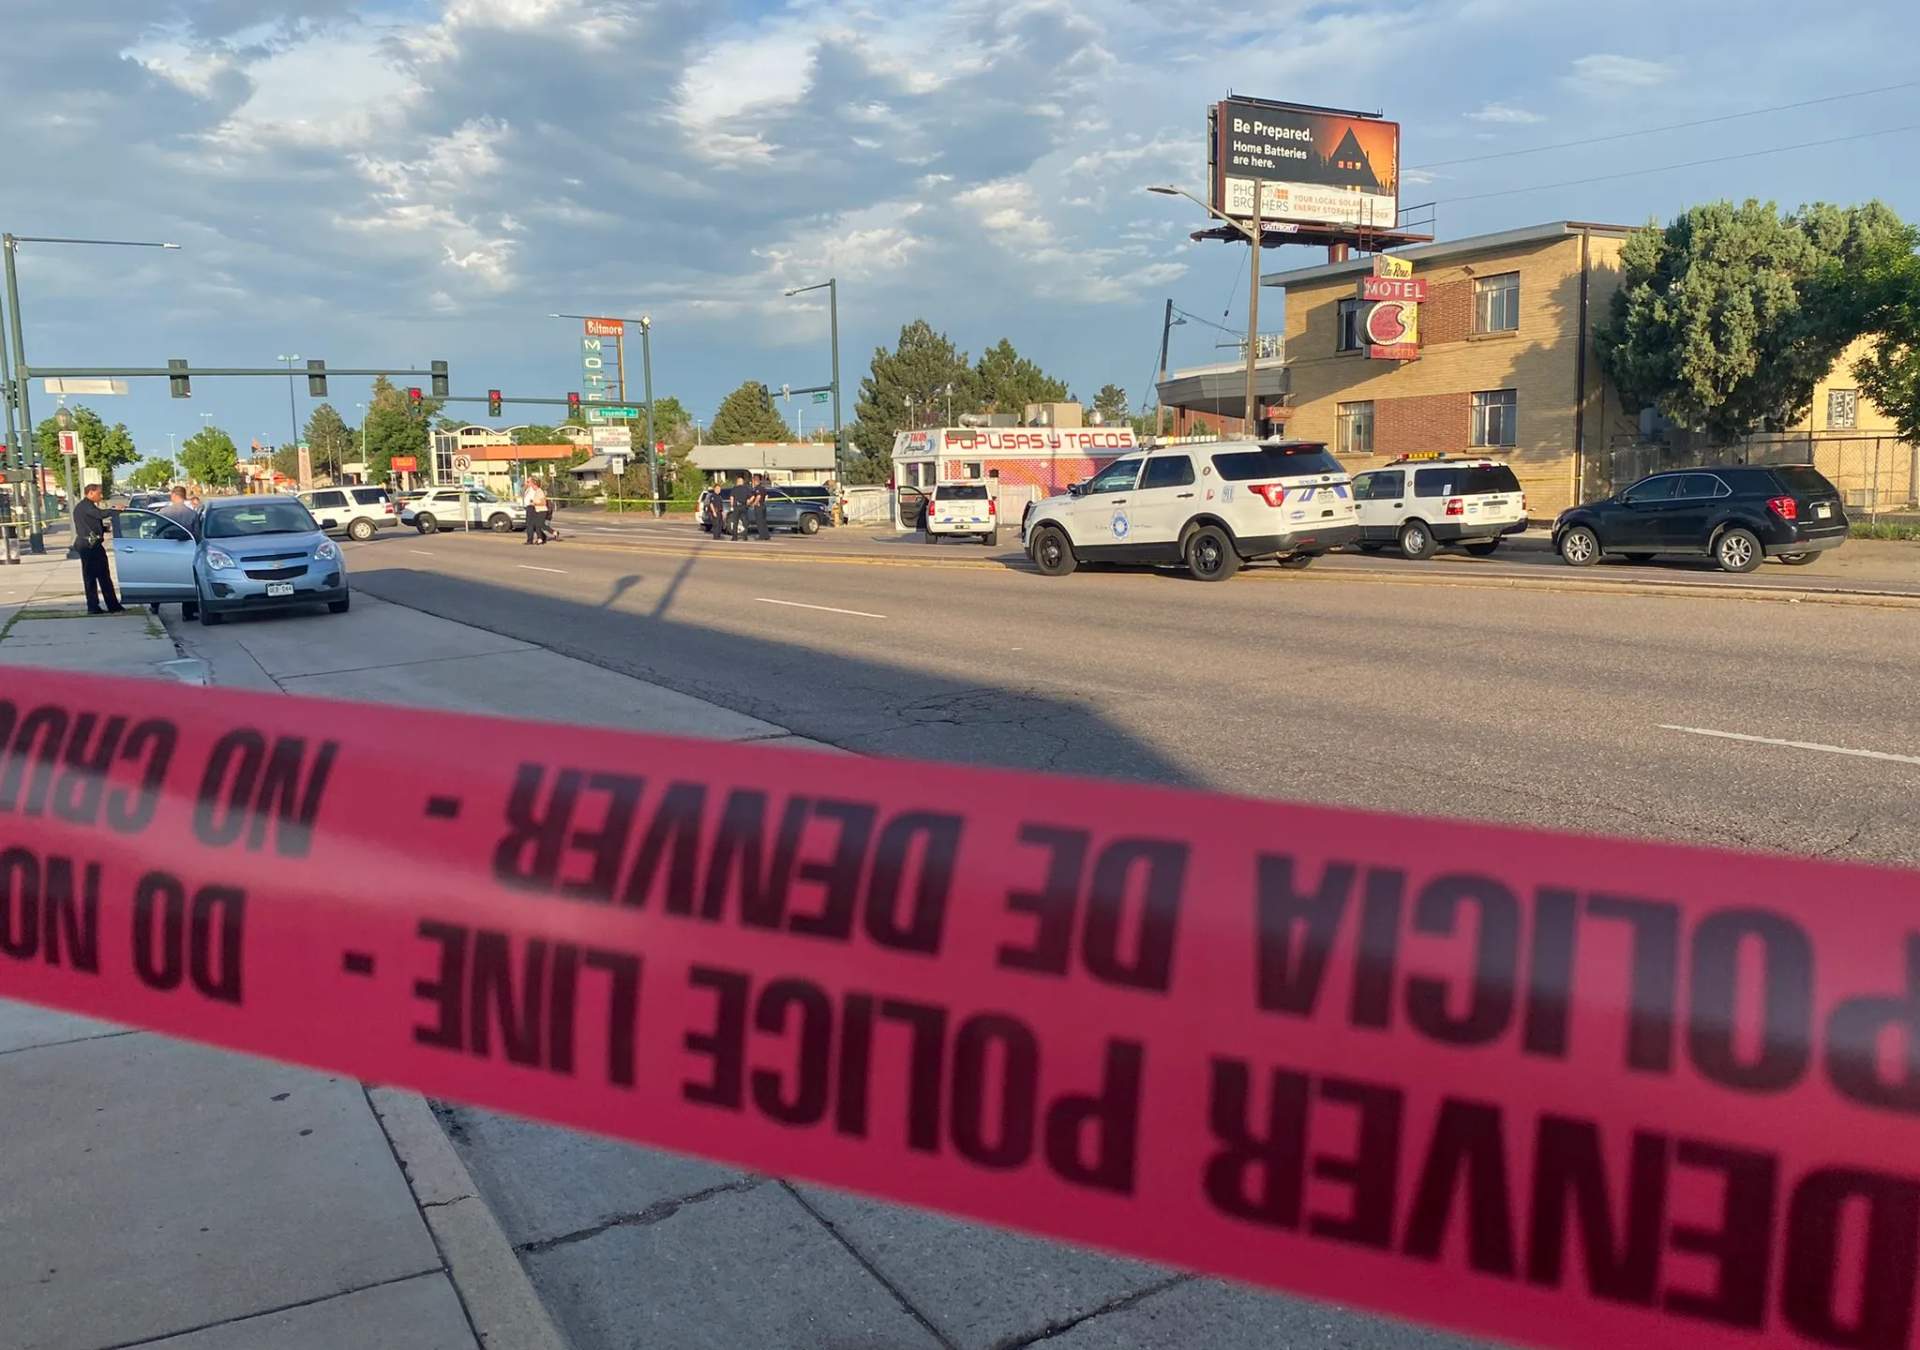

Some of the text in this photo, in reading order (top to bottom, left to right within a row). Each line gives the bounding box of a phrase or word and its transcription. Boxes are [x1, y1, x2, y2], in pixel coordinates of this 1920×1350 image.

[1233, 118, 1313, 142] Be Prepared.
[1233, 140, 1307, 160] Home Batteries
[1233, 155, 1276, 169] are here.
[1233, 184, 1277, 198] PHOON
[1233, 196, 1289, 212] BROHERS
[1364, 281, 1425, 298] MOTEL
[587, 320, 623, 335] Biltmore
[1065, 433, 1133, 449] TACOS
[193, 728, 339, 860] NO
[492, 761, 964, 958] DENVER
[996, 822, 1192, 996] DE
[1255, 849, 1920, 1120] POLICIA
[130, 870, 249, 1008] DO
[414, 917, 644, 1090] LINE
[681, 962, 1147, 1198] POLICE
[1202, 1053, 1920, 1350] DENVER
